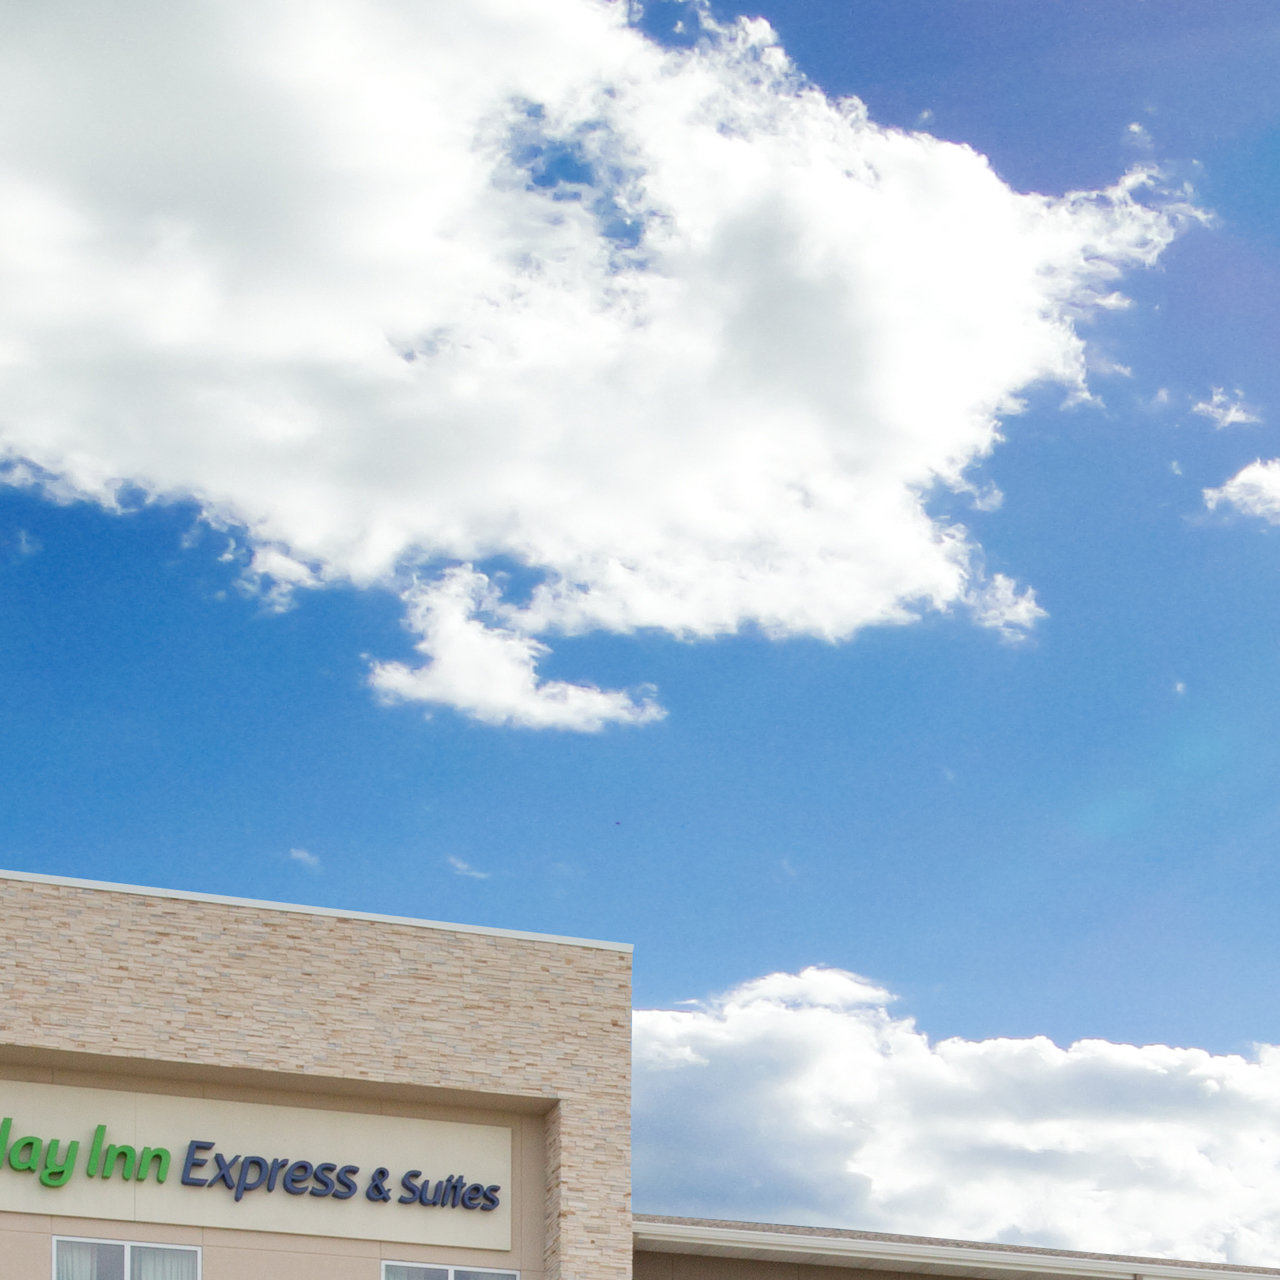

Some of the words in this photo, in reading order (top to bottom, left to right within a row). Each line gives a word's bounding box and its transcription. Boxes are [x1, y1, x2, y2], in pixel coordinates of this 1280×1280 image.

[86, 1124, 172, 1185] Inn
[180, 1139, 361, 1203] Express
[365, 1167, 393, 1204] &
[397, 1169, 502, 1212] Suites
